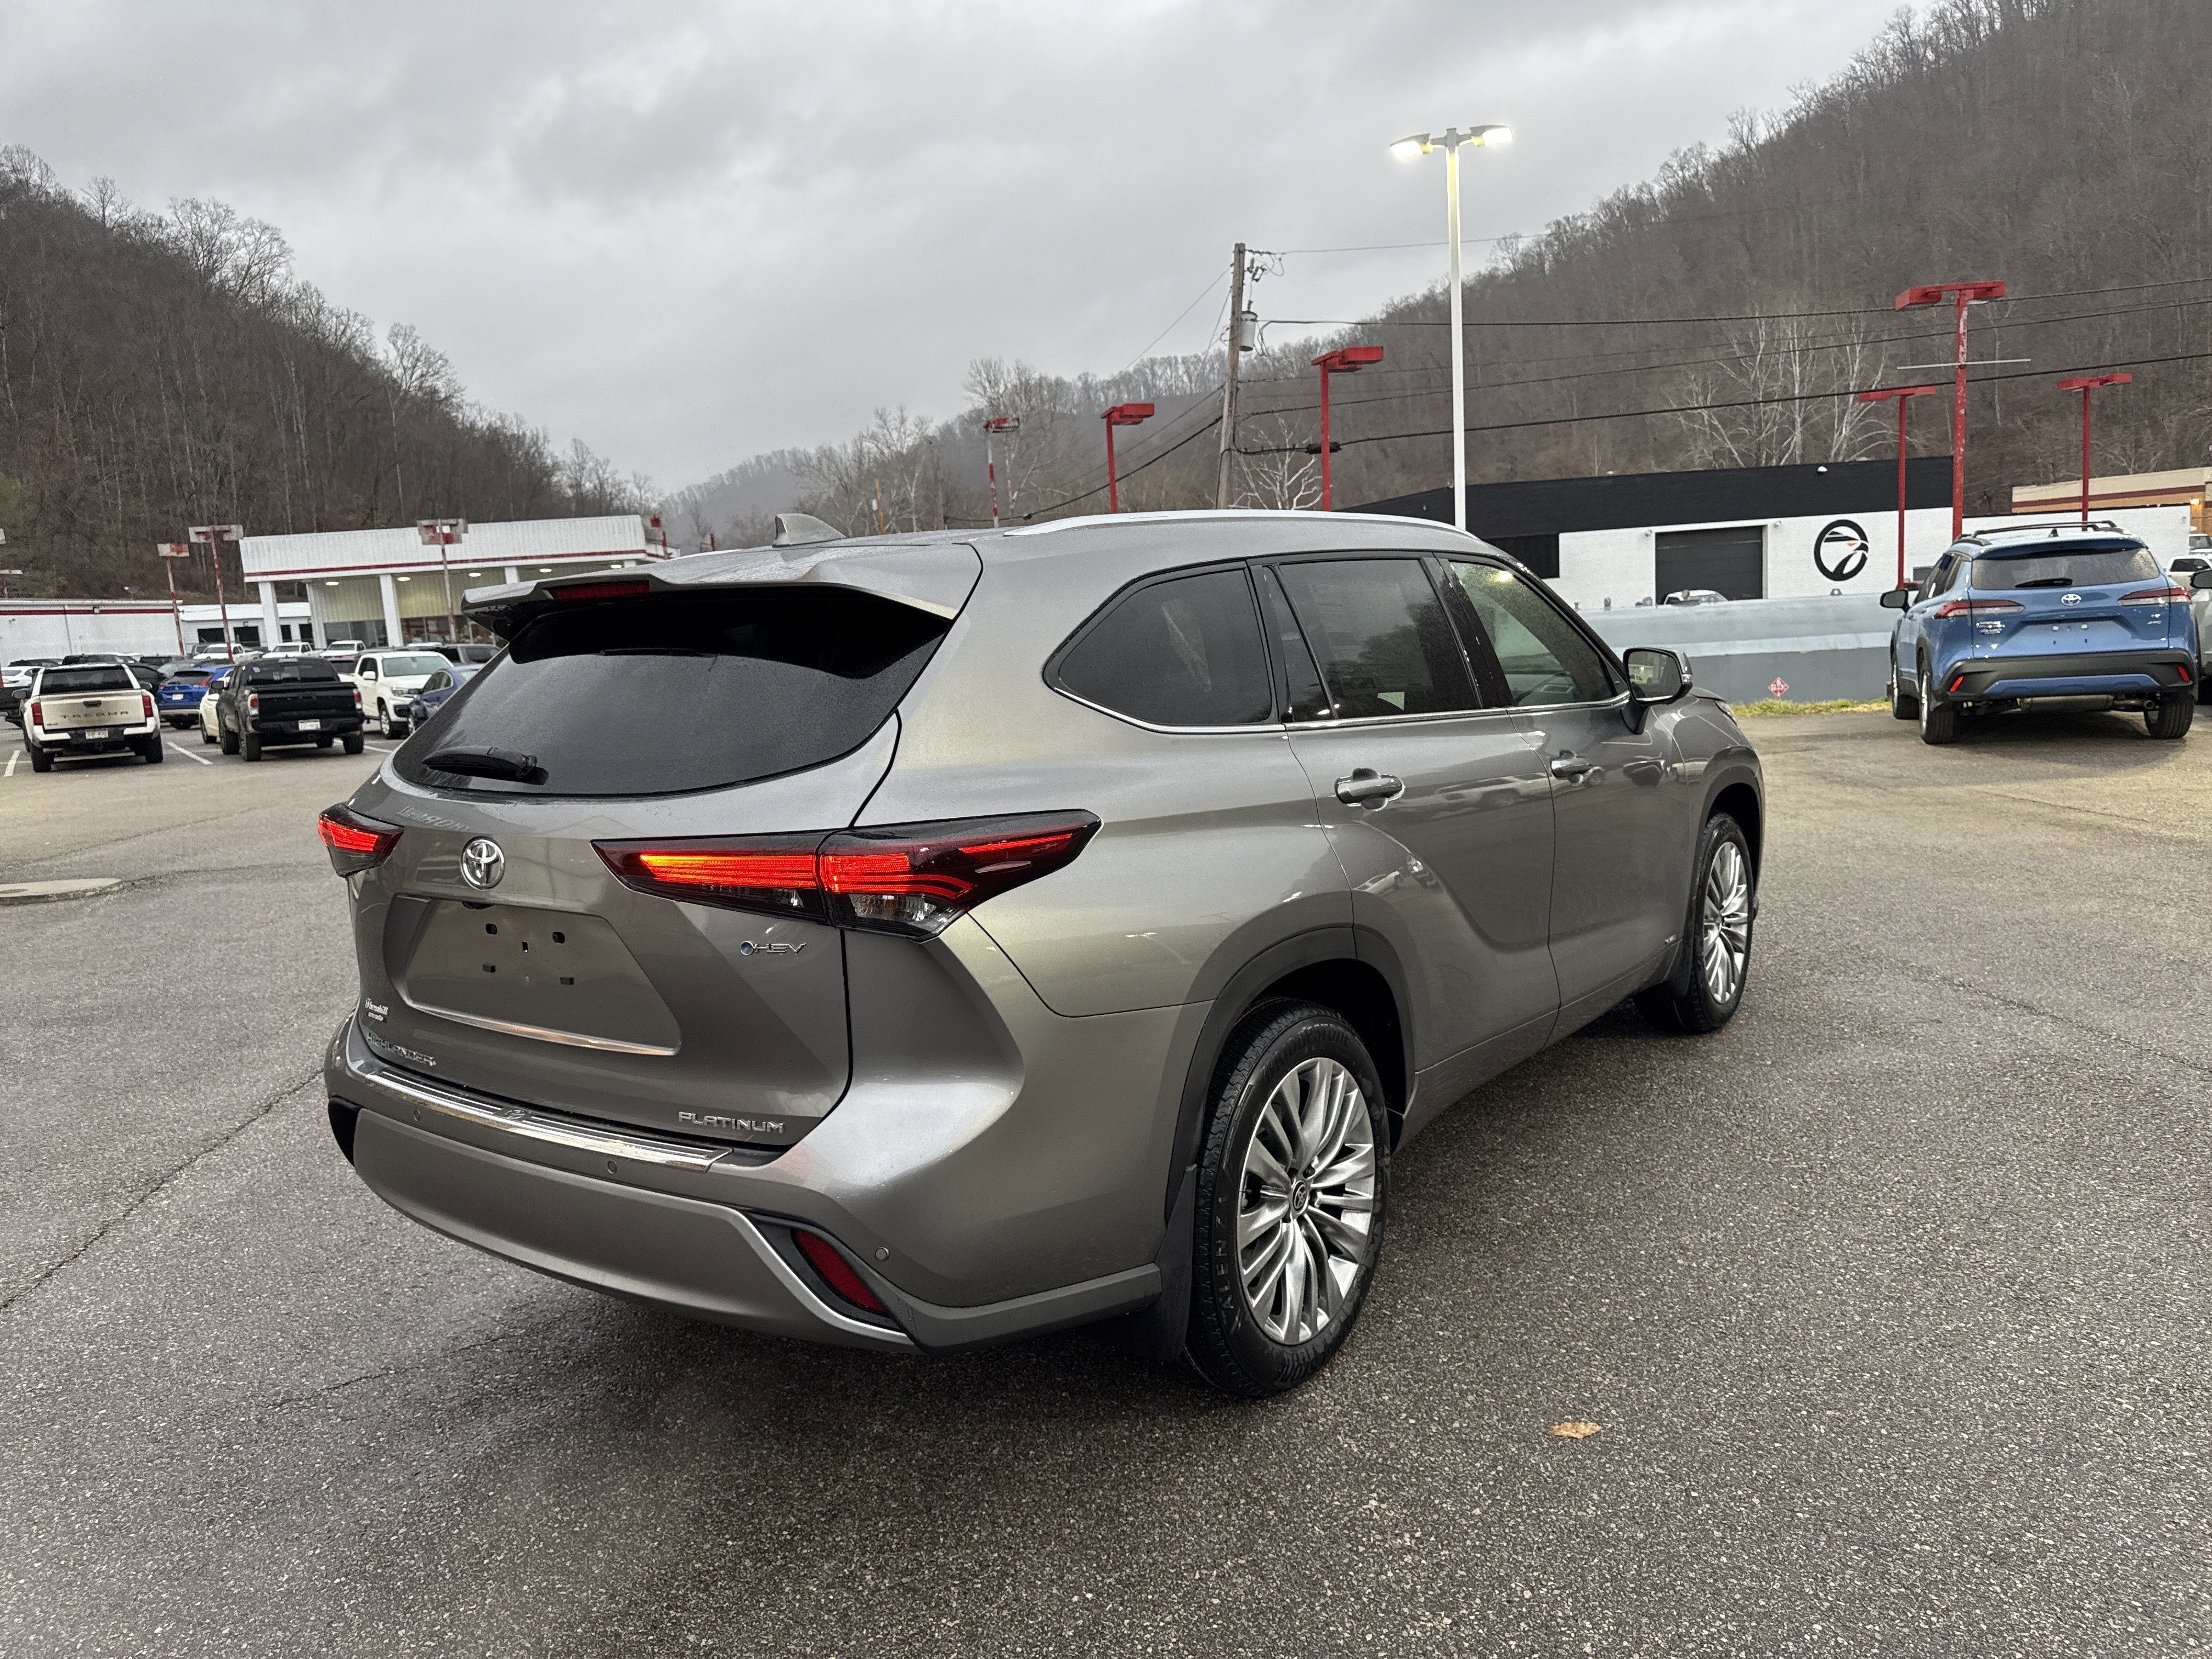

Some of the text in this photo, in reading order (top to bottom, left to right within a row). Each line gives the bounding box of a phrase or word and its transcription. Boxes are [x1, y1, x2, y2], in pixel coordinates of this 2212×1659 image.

[60, 710, 129, 719] TACOMA
[754, 943, 806, 954] HEV
[366, 1032, 436, 1066] HIGHLANDER
[679, 1111, 785, 1133] PLATINUM
